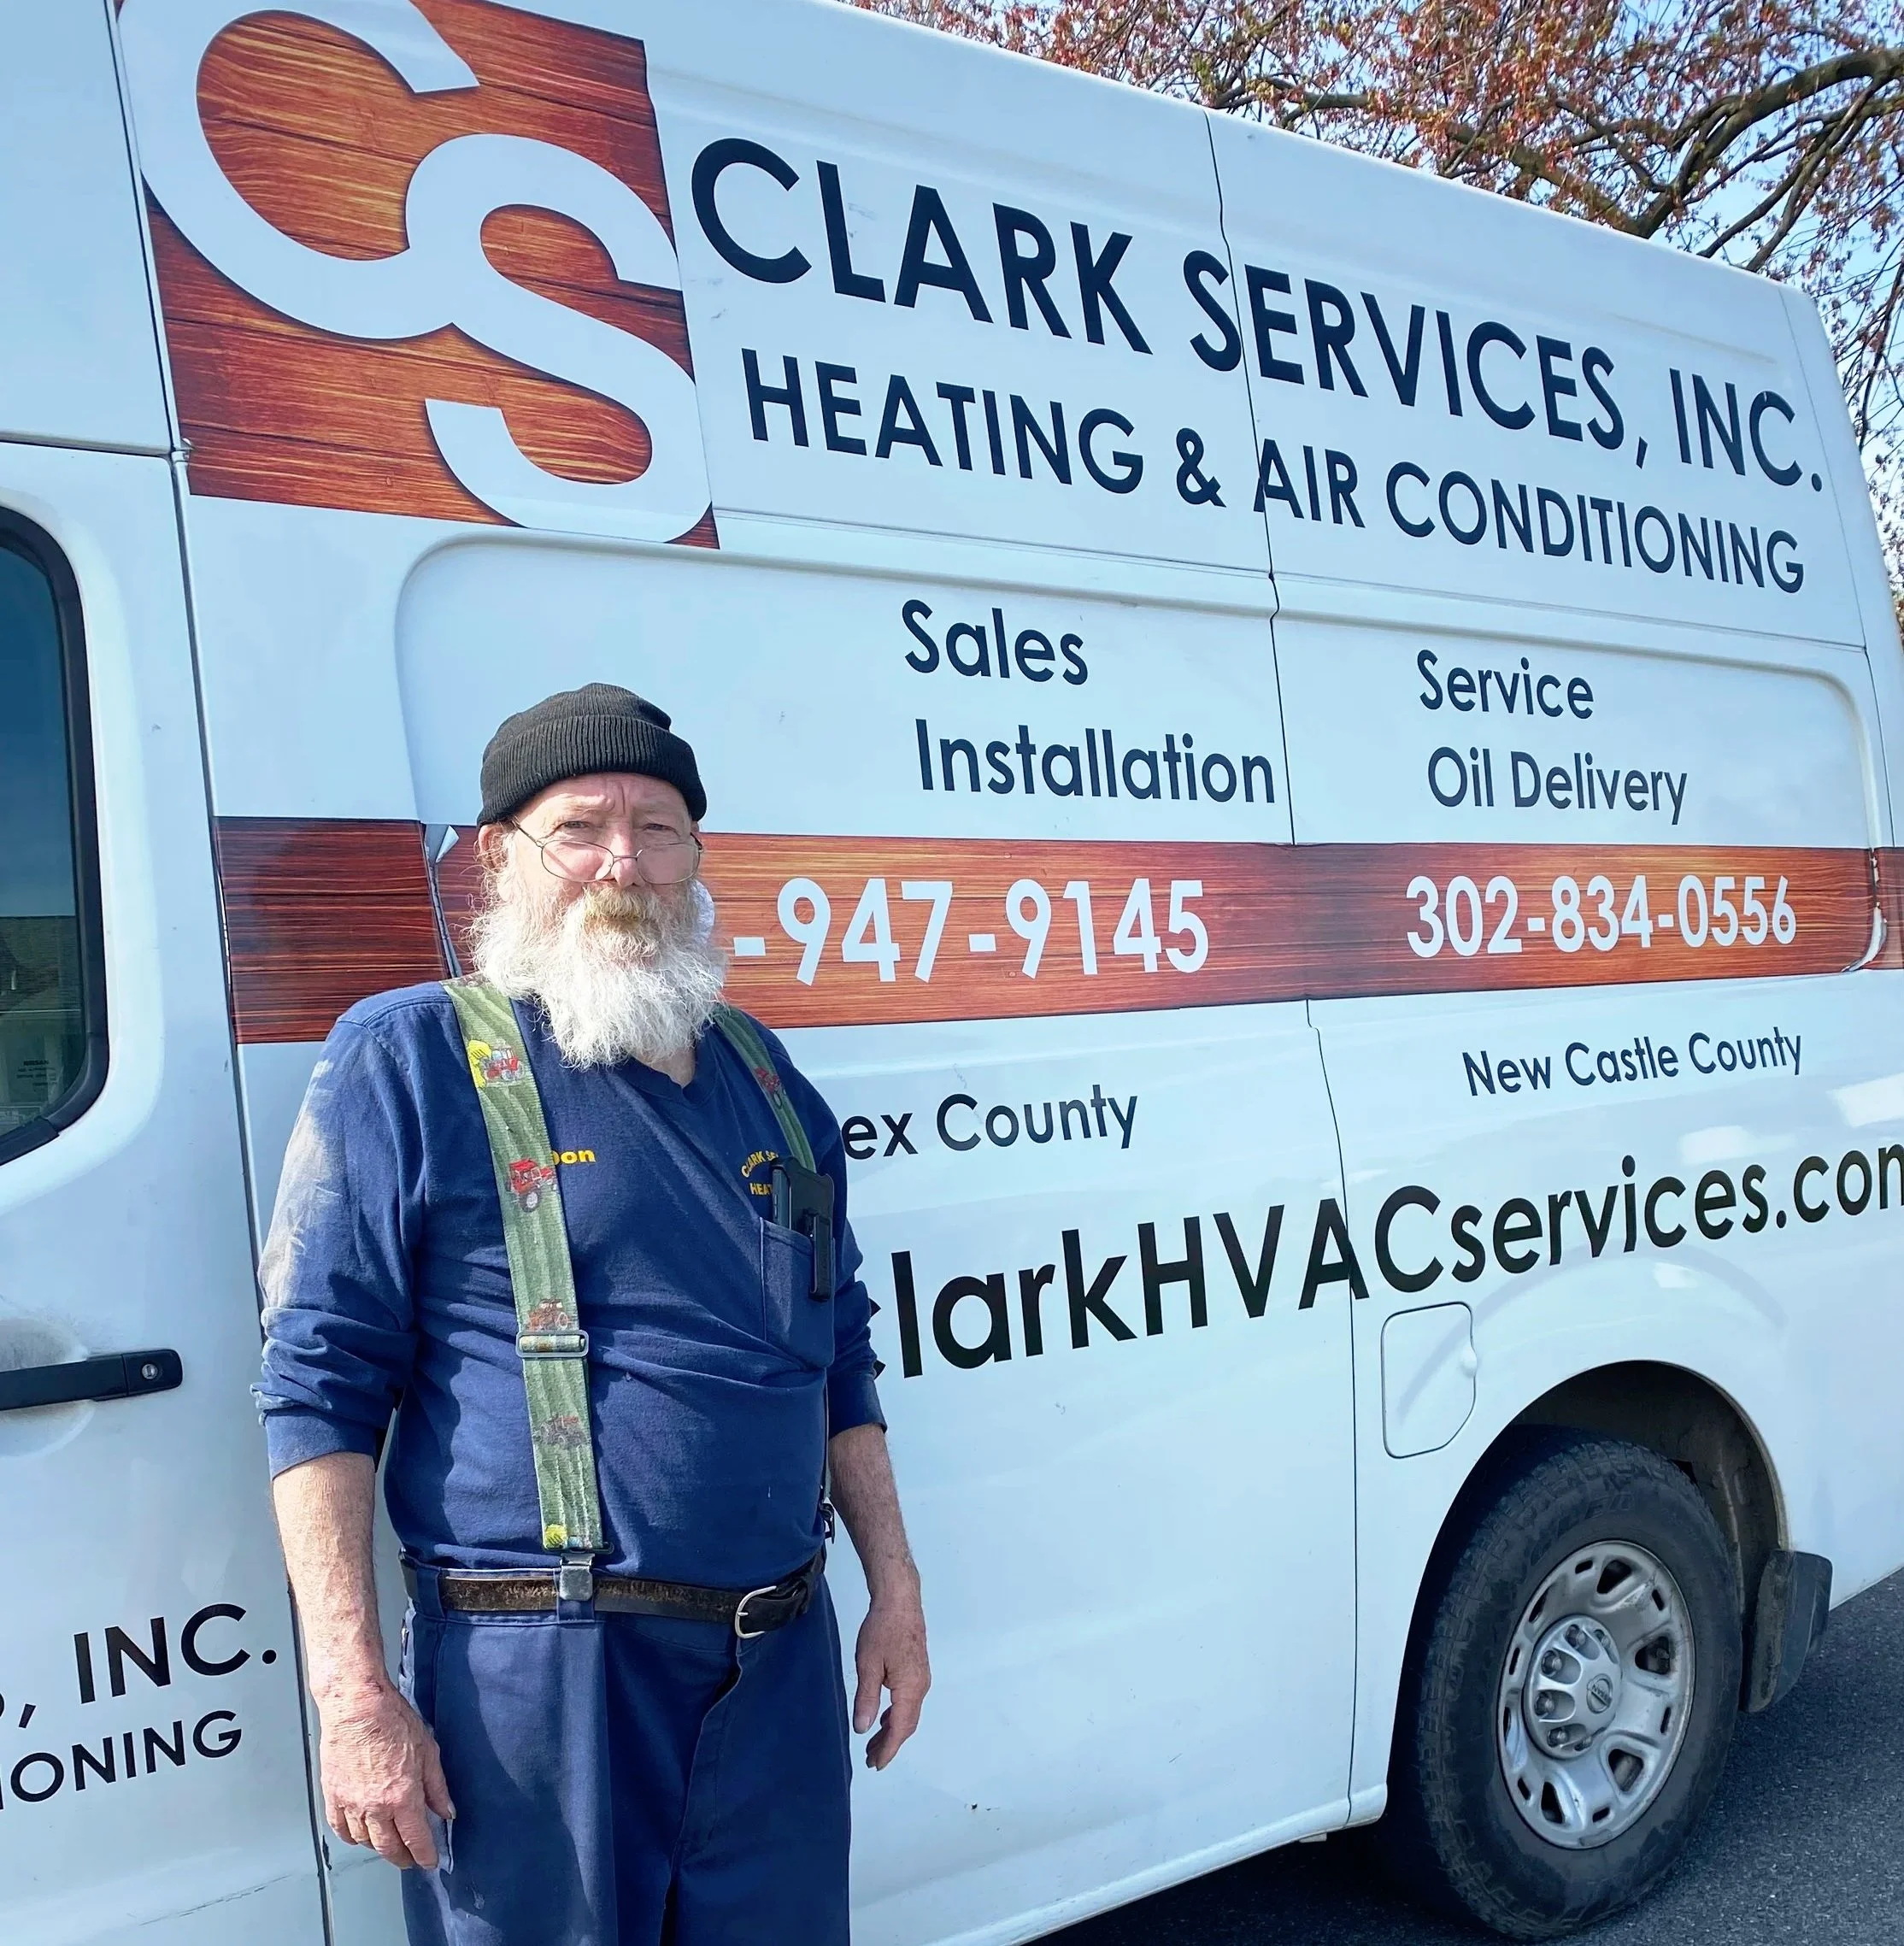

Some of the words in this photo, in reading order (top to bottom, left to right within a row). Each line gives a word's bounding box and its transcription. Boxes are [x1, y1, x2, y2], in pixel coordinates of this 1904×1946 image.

[690, 138, 1154, 356] CLARK
[1183, 250, 1648, 469] SERVICES,
[1669, 367, 1823, 492] INC.
[741, 348, 1143, 495] HEATING
[1176, 427, 1227, 508] &
[1252, 438, 1366, 528] AIR
[1385, 462, 1804, 594] CONDITIONING
[902, 599, 1089, 685] Sales
[1417, 649, 1594, 720] Service
[915, 718, 1275, 803] Installation
[1427, 746, 1495, 808] Oil
[1510, 750, 1688, 826] Delivery
[1406, 875, 1796, 958] 302-834-0556
[1462, 1050, 1551, 1096] New
[1565, 1036, 1679, 1086] Castle
[1689, 1026, 1801, 1076] County
[936, 1084, 1138, 1151] County
[741, 1150, 767, 1178] CLARK
[766, 1149, 779, 1161] SE
[869, 1143, 1904, 1379] larkHVACservices.co
[73, 1603, 277, 1704] INC.
